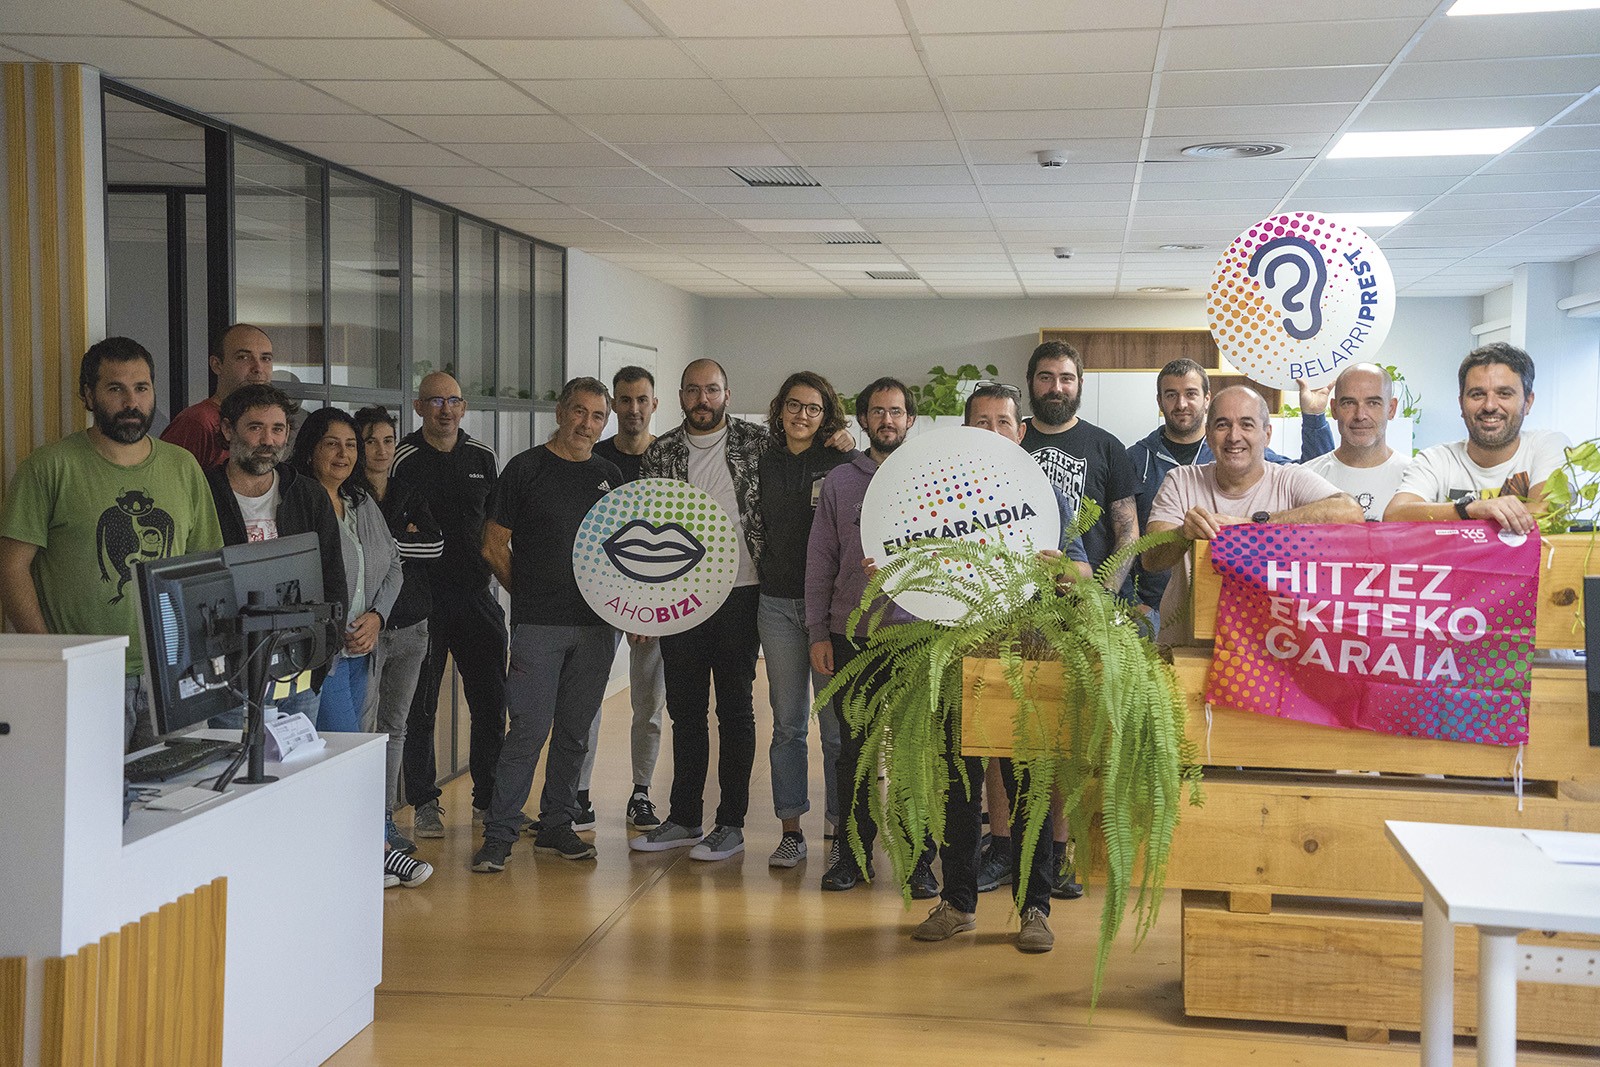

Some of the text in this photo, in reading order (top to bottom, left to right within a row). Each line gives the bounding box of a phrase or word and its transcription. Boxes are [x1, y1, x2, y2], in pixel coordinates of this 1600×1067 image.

[1460, 528, 1486, 539] 365
[1266, 560, 1453, 601] HITZEZ
[604, 593, 703, 623] AHOBIZI
[1269, 596, 1487, 642] EKITEKO
[1265, 625, 1462, 682] GARAIA
